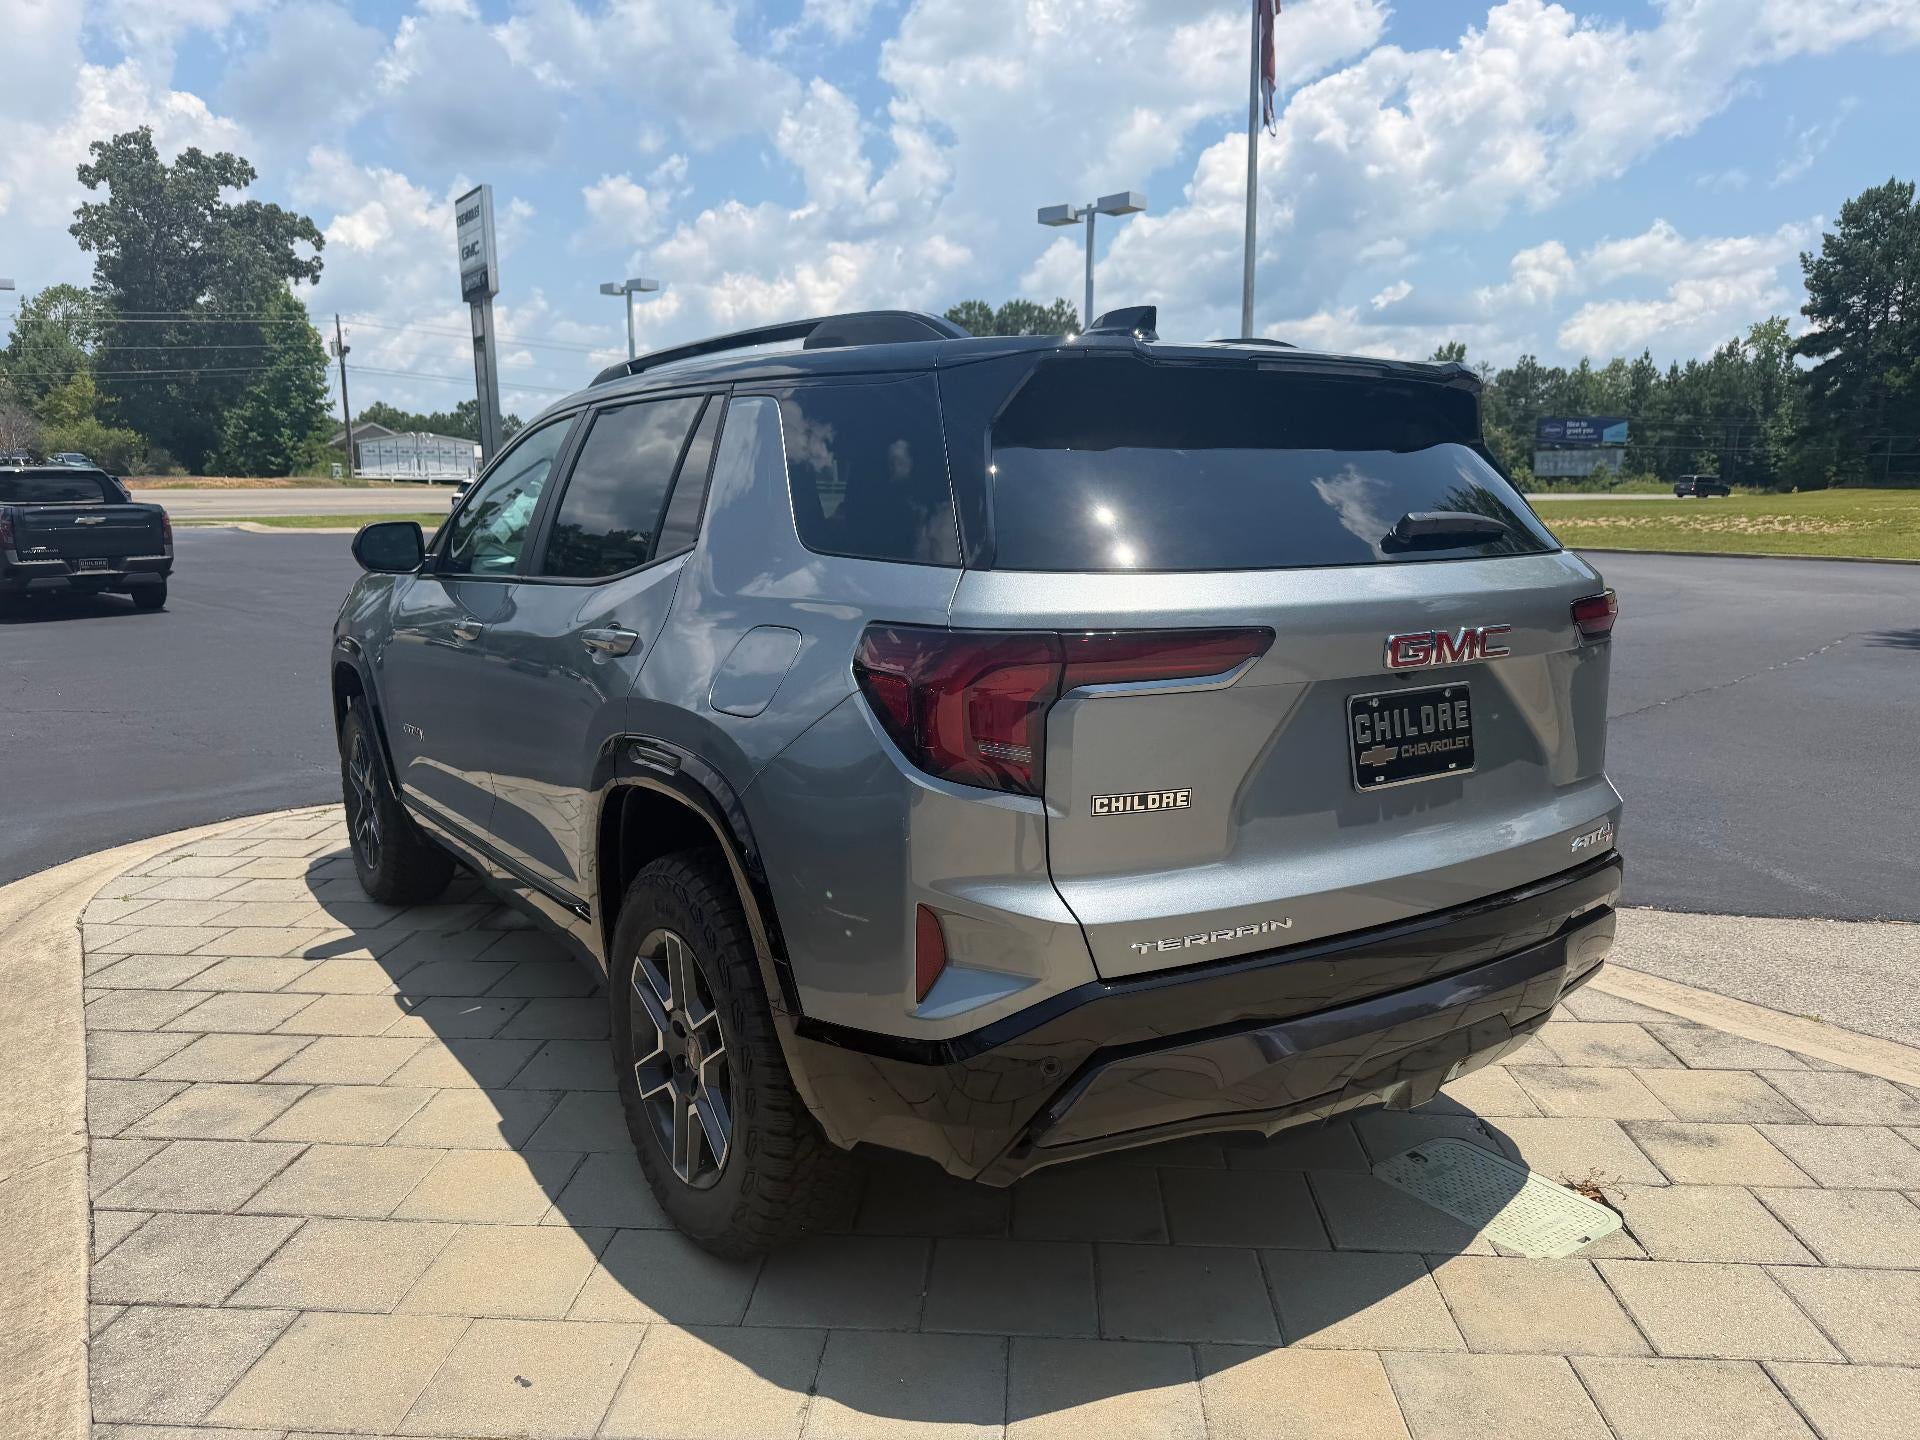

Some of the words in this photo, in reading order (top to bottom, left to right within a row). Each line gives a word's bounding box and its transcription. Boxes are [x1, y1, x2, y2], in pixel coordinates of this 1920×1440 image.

[461, 240, 480, 261] GMC
[1383, 624, 1511, 669] GMC
[1354, 700, 1469, 744] CHILDRE
[1401, 736, 1470, 757] CHEVROLET
[1095, 791, 1189, 813] CHILDRE
[1571, 822, 1614, 852] AT4
[1130, 917, 1293, 955] TERRAIN
